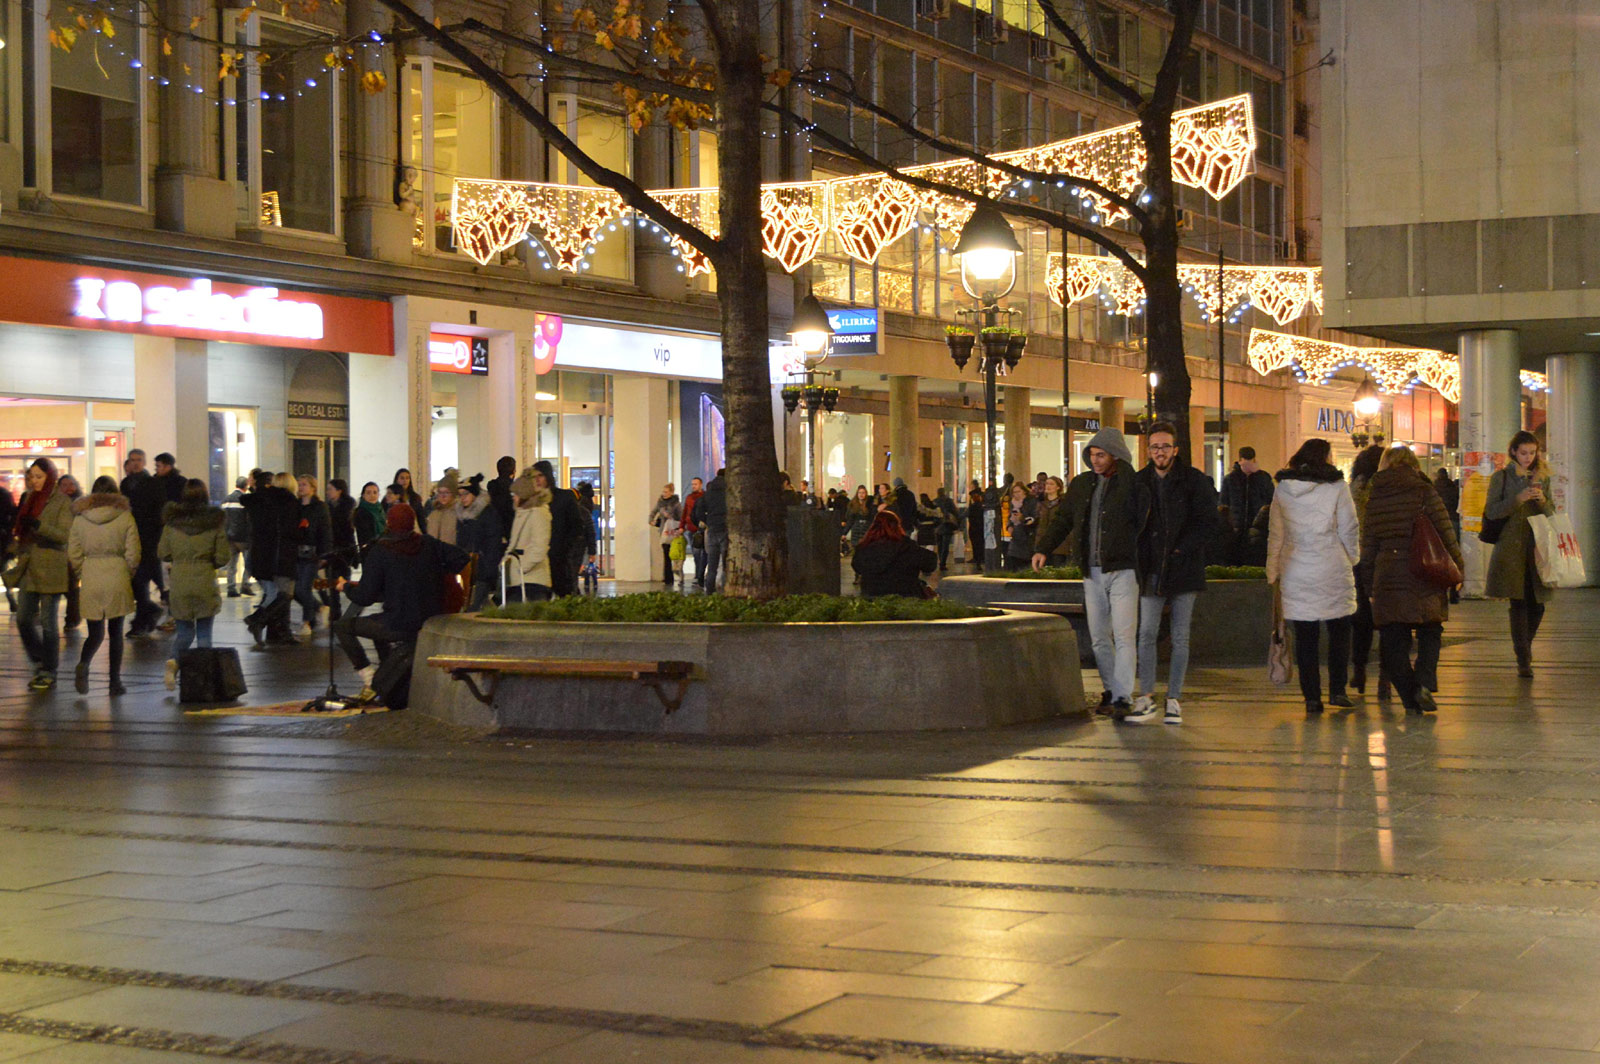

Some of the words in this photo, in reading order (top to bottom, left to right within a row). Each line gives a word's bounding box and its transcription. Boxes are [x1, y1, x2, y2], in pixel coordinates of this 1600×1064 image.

[841, 317, 876, 326] ILIRIKA
[832, 334, 871, 344] TRGOVANJE
[653, 342, 671, 367] vip
[288, 403, 305, 416] BEO
[306, 405, 326, 418] REAL
[1316, 407, 1355, 434] ALDO
